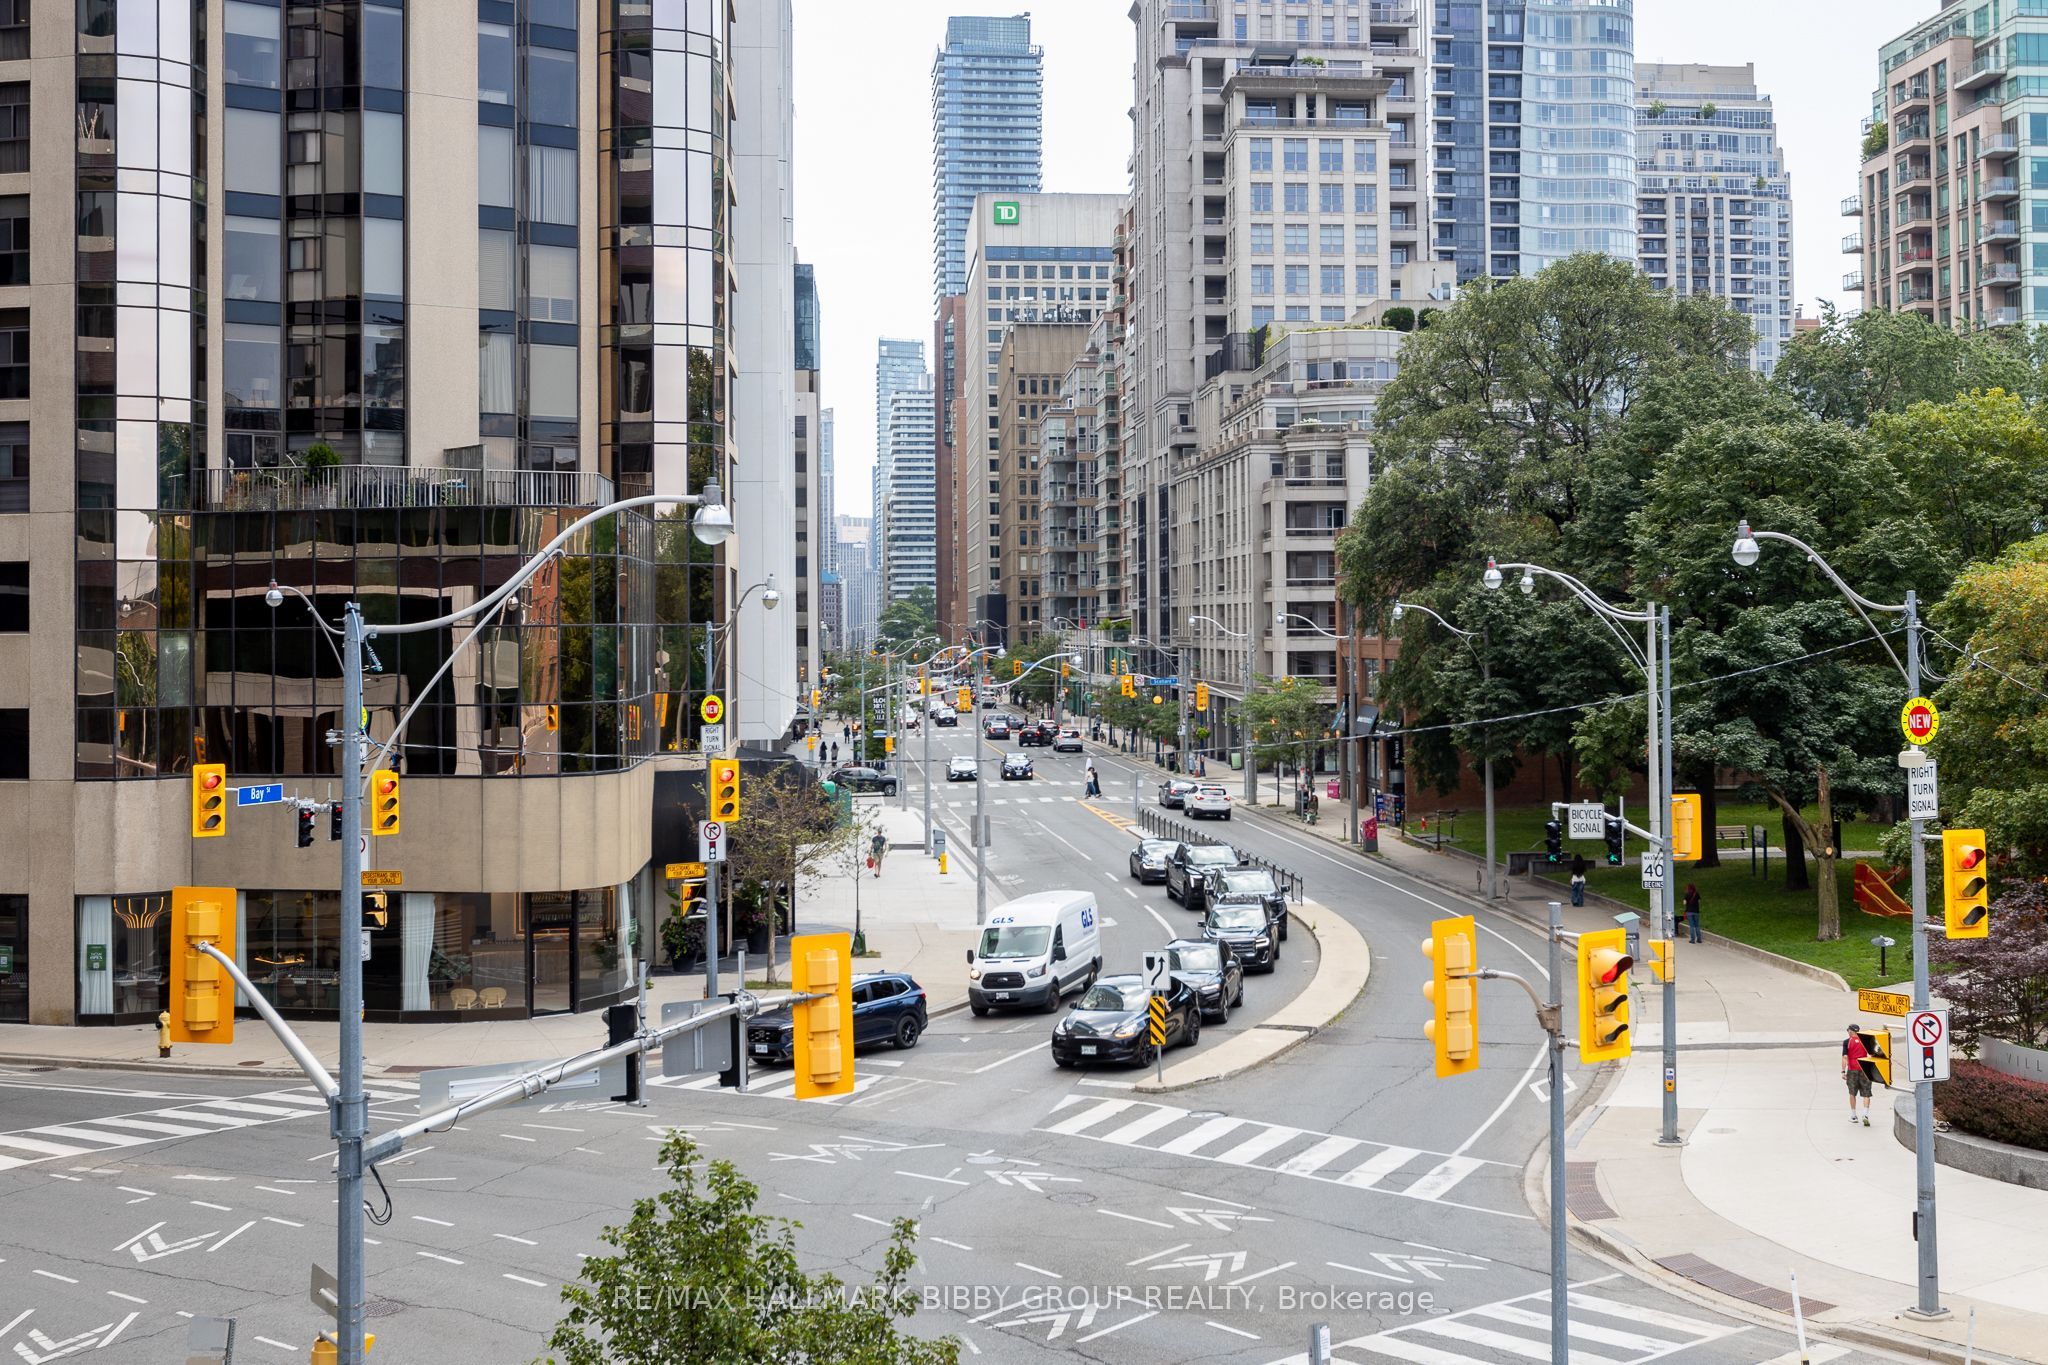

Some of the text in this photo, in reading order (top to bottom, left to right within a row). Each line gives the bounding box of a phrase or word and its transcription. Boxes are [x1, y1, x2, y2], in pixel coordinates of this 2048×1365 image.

[997, 206, 1016, 219] TD
[705, 705, 719, 714] NEW
[1909, 714, 1931, 728] NEW
[1911, 767, 1933, 778] RIGHT
[251, 788, 264, 801] Bay
[1913, 783, 1934, 795] TURN
[1911, 801, 1936, 812] SIGNAL
[1572, 810, 1602, 819] BICYCLE
[1573, 823, 1601, 833] SIGNAL
[1644, 864, 1664, 877] 40
[992, 916, 1014, 924] GLS
[1081, 908, 1093, 928] GLS
[1860, 991, 1908, 1008] PEDESTRIANS OBEY
[1868, 1001, 1902, 1014] YOUR SIGNALS
